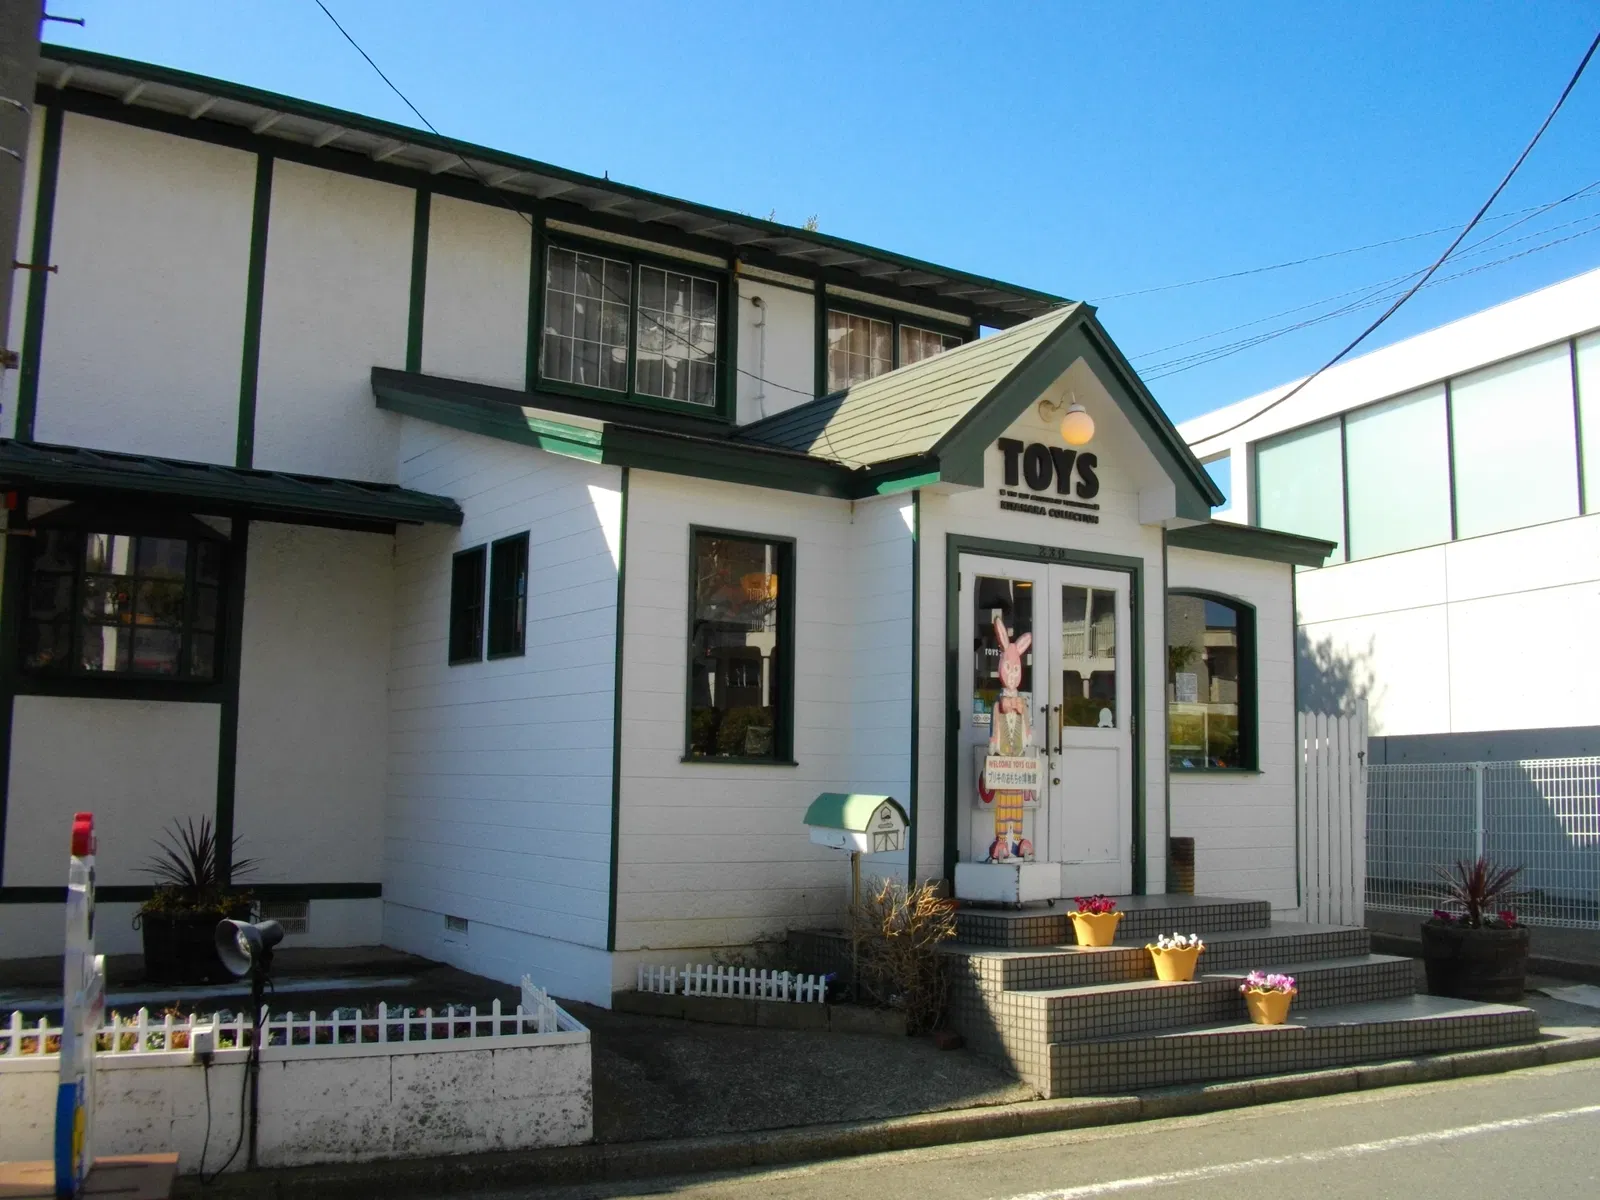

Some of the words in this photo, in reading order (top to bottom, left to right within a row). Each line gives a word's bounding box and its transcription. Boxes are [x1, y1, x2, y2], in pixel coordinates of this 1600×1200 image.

[998, 437, 1100, 499] TOYS
[1048, 508, 1100, 524] COLLECTION
[988, 759, 1012, 769] WELCOME
[1013, 760, 1025, 769] TOYS
[1025, 761, 1037, 769] CLUB
[988, 771, 1037, 785] ブリキのおもちゃ博物館
